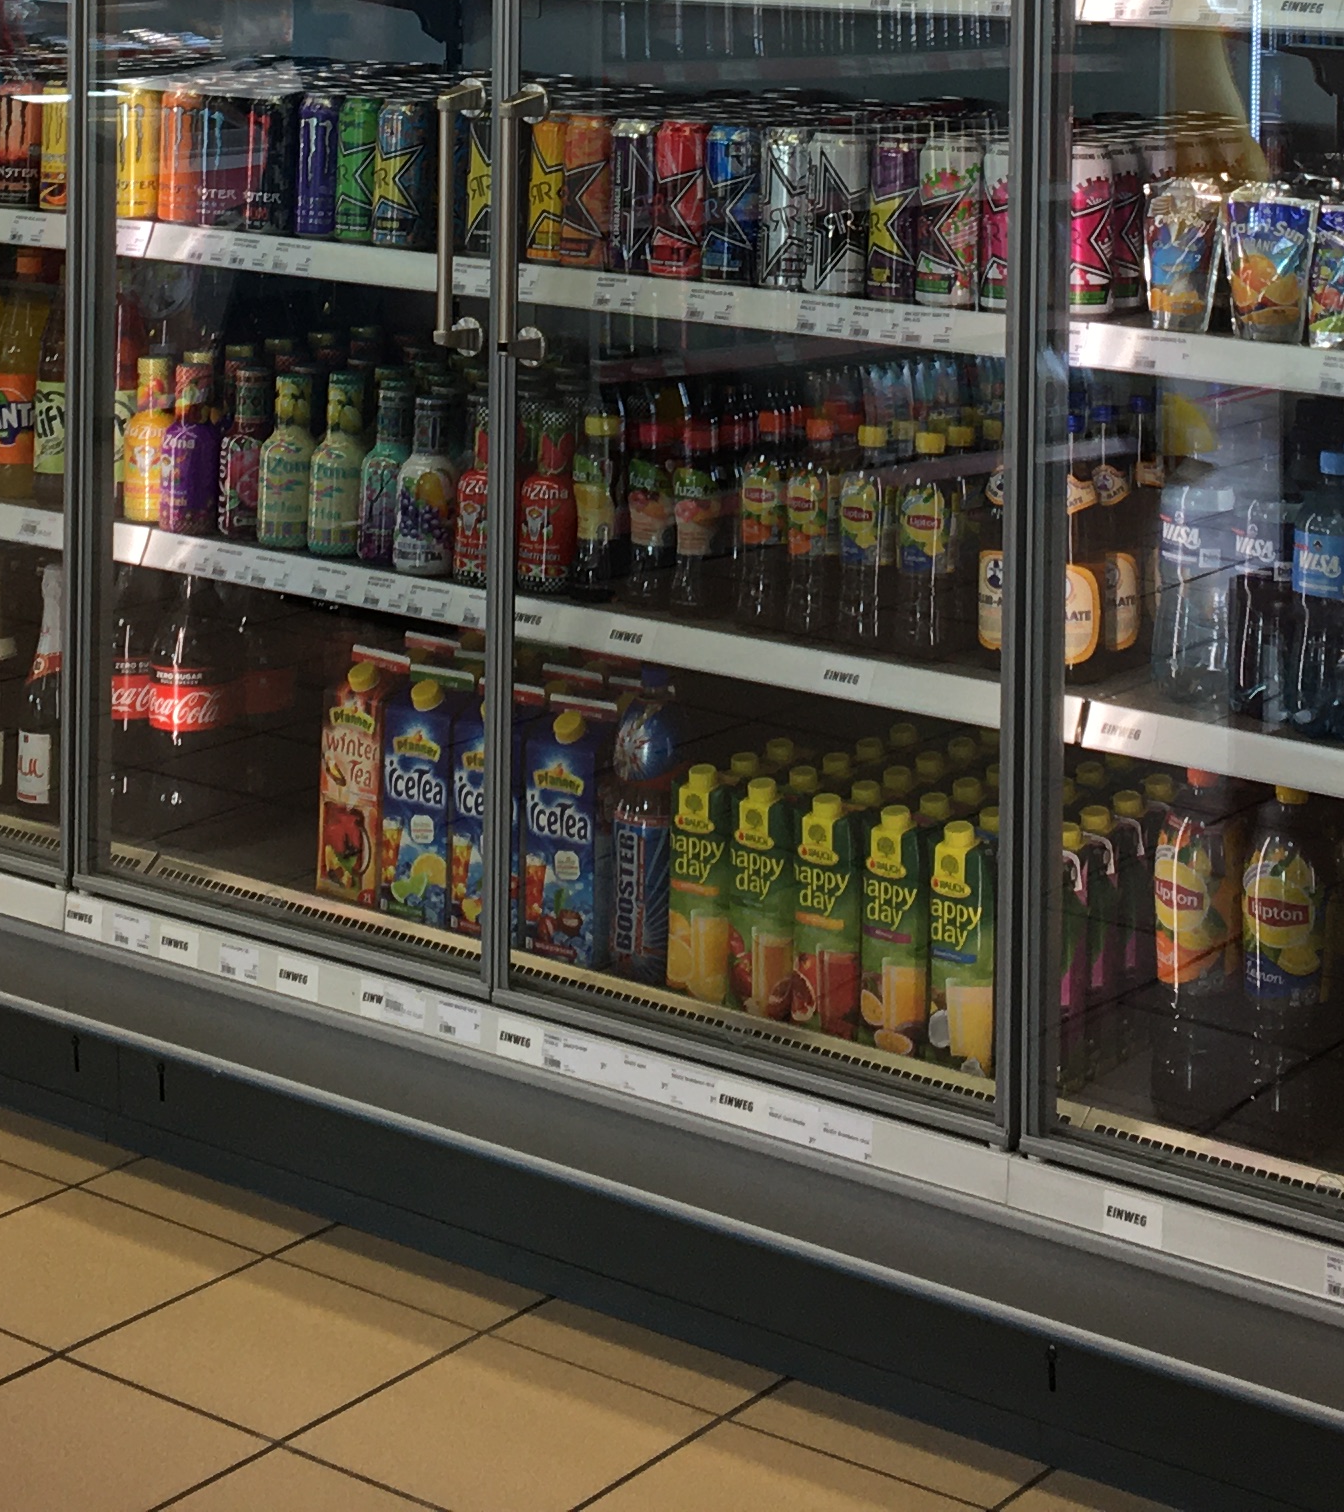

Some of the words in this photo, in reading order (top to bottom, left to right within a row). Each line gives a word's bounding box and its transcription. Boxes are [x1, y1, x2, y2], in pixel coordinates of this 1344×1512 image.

[1281, 0, 1324, 14] EINWEG
[1299, 550, 1341, 576] VILSA
[609, 629, 643, 645] EINWEG
[824, 669, 859, 686] EINWEG
[1101, 722, 1142, 741] EINWEG
[325, 732, 378, 760] Winter
[348, 760, 372, 787] Tea
[675, 855, 712, 883] day
[616, 828, 637, 954] BOOSTER
[736, 873, 771, 901] day
[800, 887, 836, 916] day
[1251, 899, 1304, 924] Lipton
[66, 909, 93, 925] EINWEG
[867, 902, 904, 932] day
[161, 934, 189, 952] EINWEG
[931, 922, 968, 950] day
[278, 967, 308, 986] EINWEG
[499, 1030, 531, 1048] EINWEG
[719, 1093, 753, 1112] EINWEG
[1106, 1204, 1147, 1227] EINWEG
